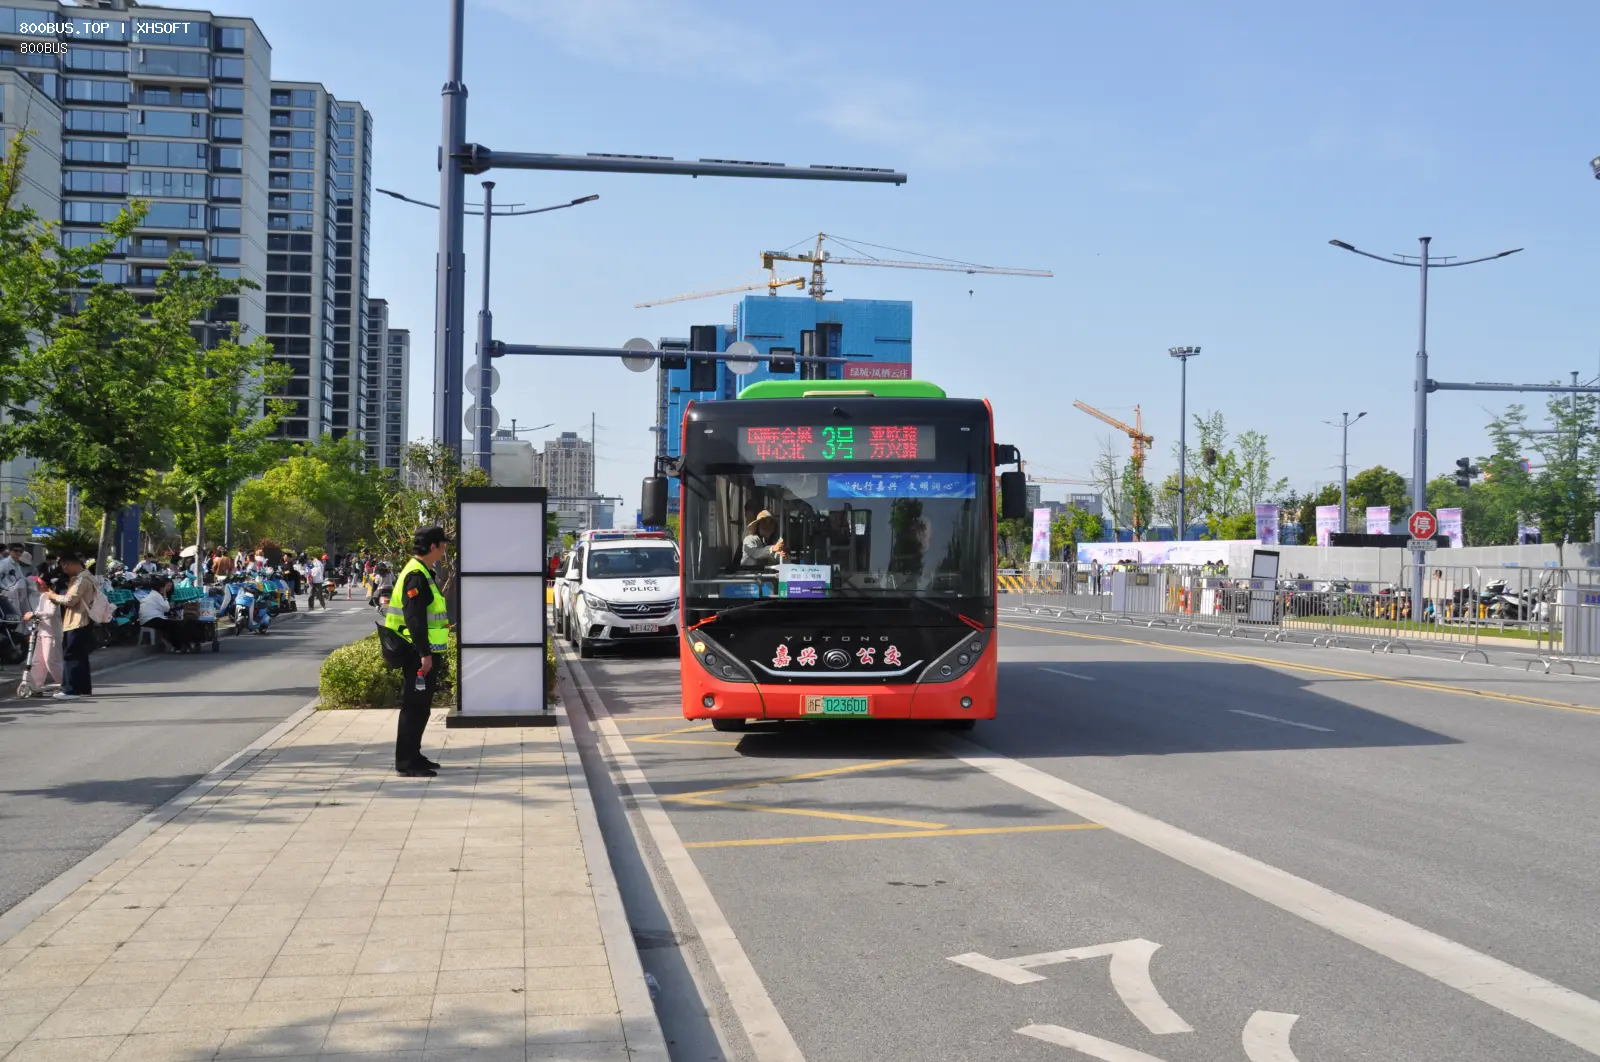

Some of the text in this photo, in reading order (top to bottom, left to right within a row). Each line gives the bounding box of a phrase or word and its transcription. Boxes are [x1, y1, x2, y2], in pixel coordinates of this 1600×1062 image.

[747, 426, 813, 444] 国际会展
[821, 426, 855, 461] 3号
[756, 443, 806, 461] 中心北
[1411, 514, 1432, 535] 停
[772, 644, 901, 668] 嘉兴 公交
